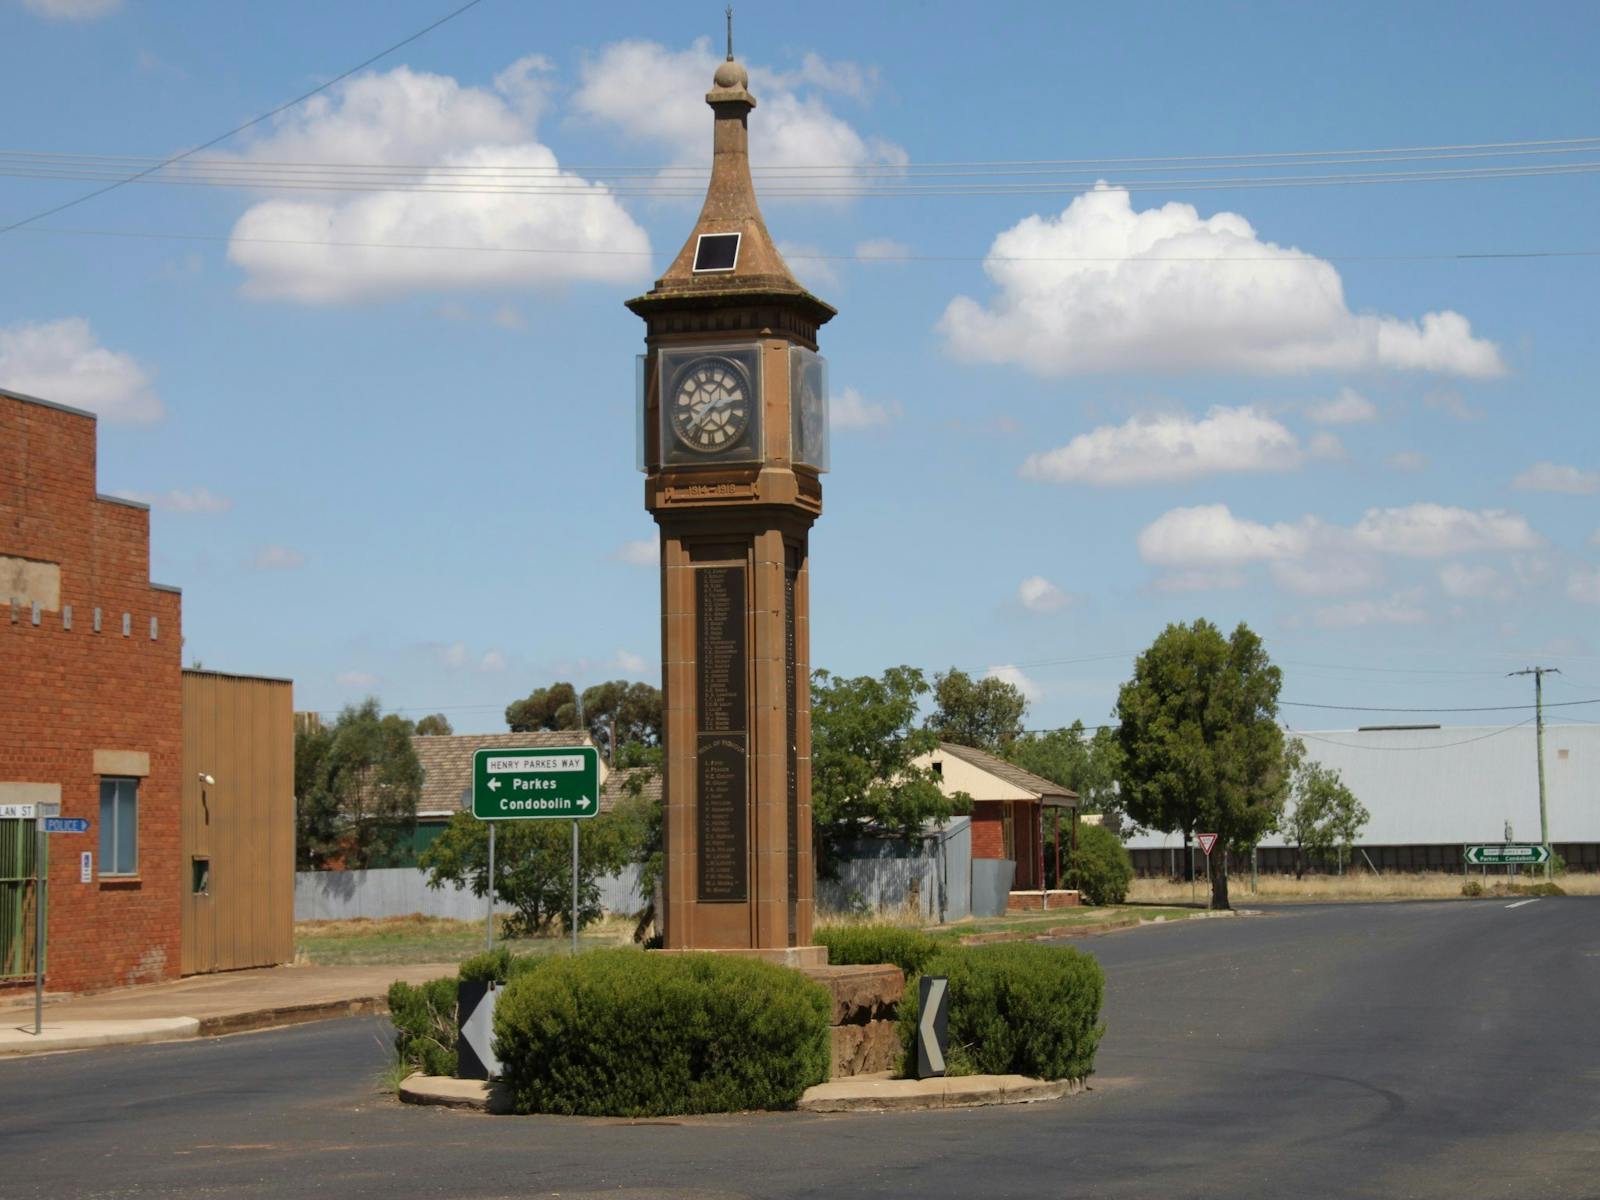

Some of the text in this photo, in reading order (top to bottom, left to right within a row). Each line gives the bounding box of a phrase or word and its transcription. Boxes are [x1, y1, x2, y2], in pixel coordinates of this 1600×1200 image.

[490, 759, 580, 770] HENRY PARKES WAY
[513, 778, 557, 790] Parkes
[500, 798, 571, 810] Condobolin
[22, 805, 32, 816] ST
[47, 819, 78, 831] POLICE
